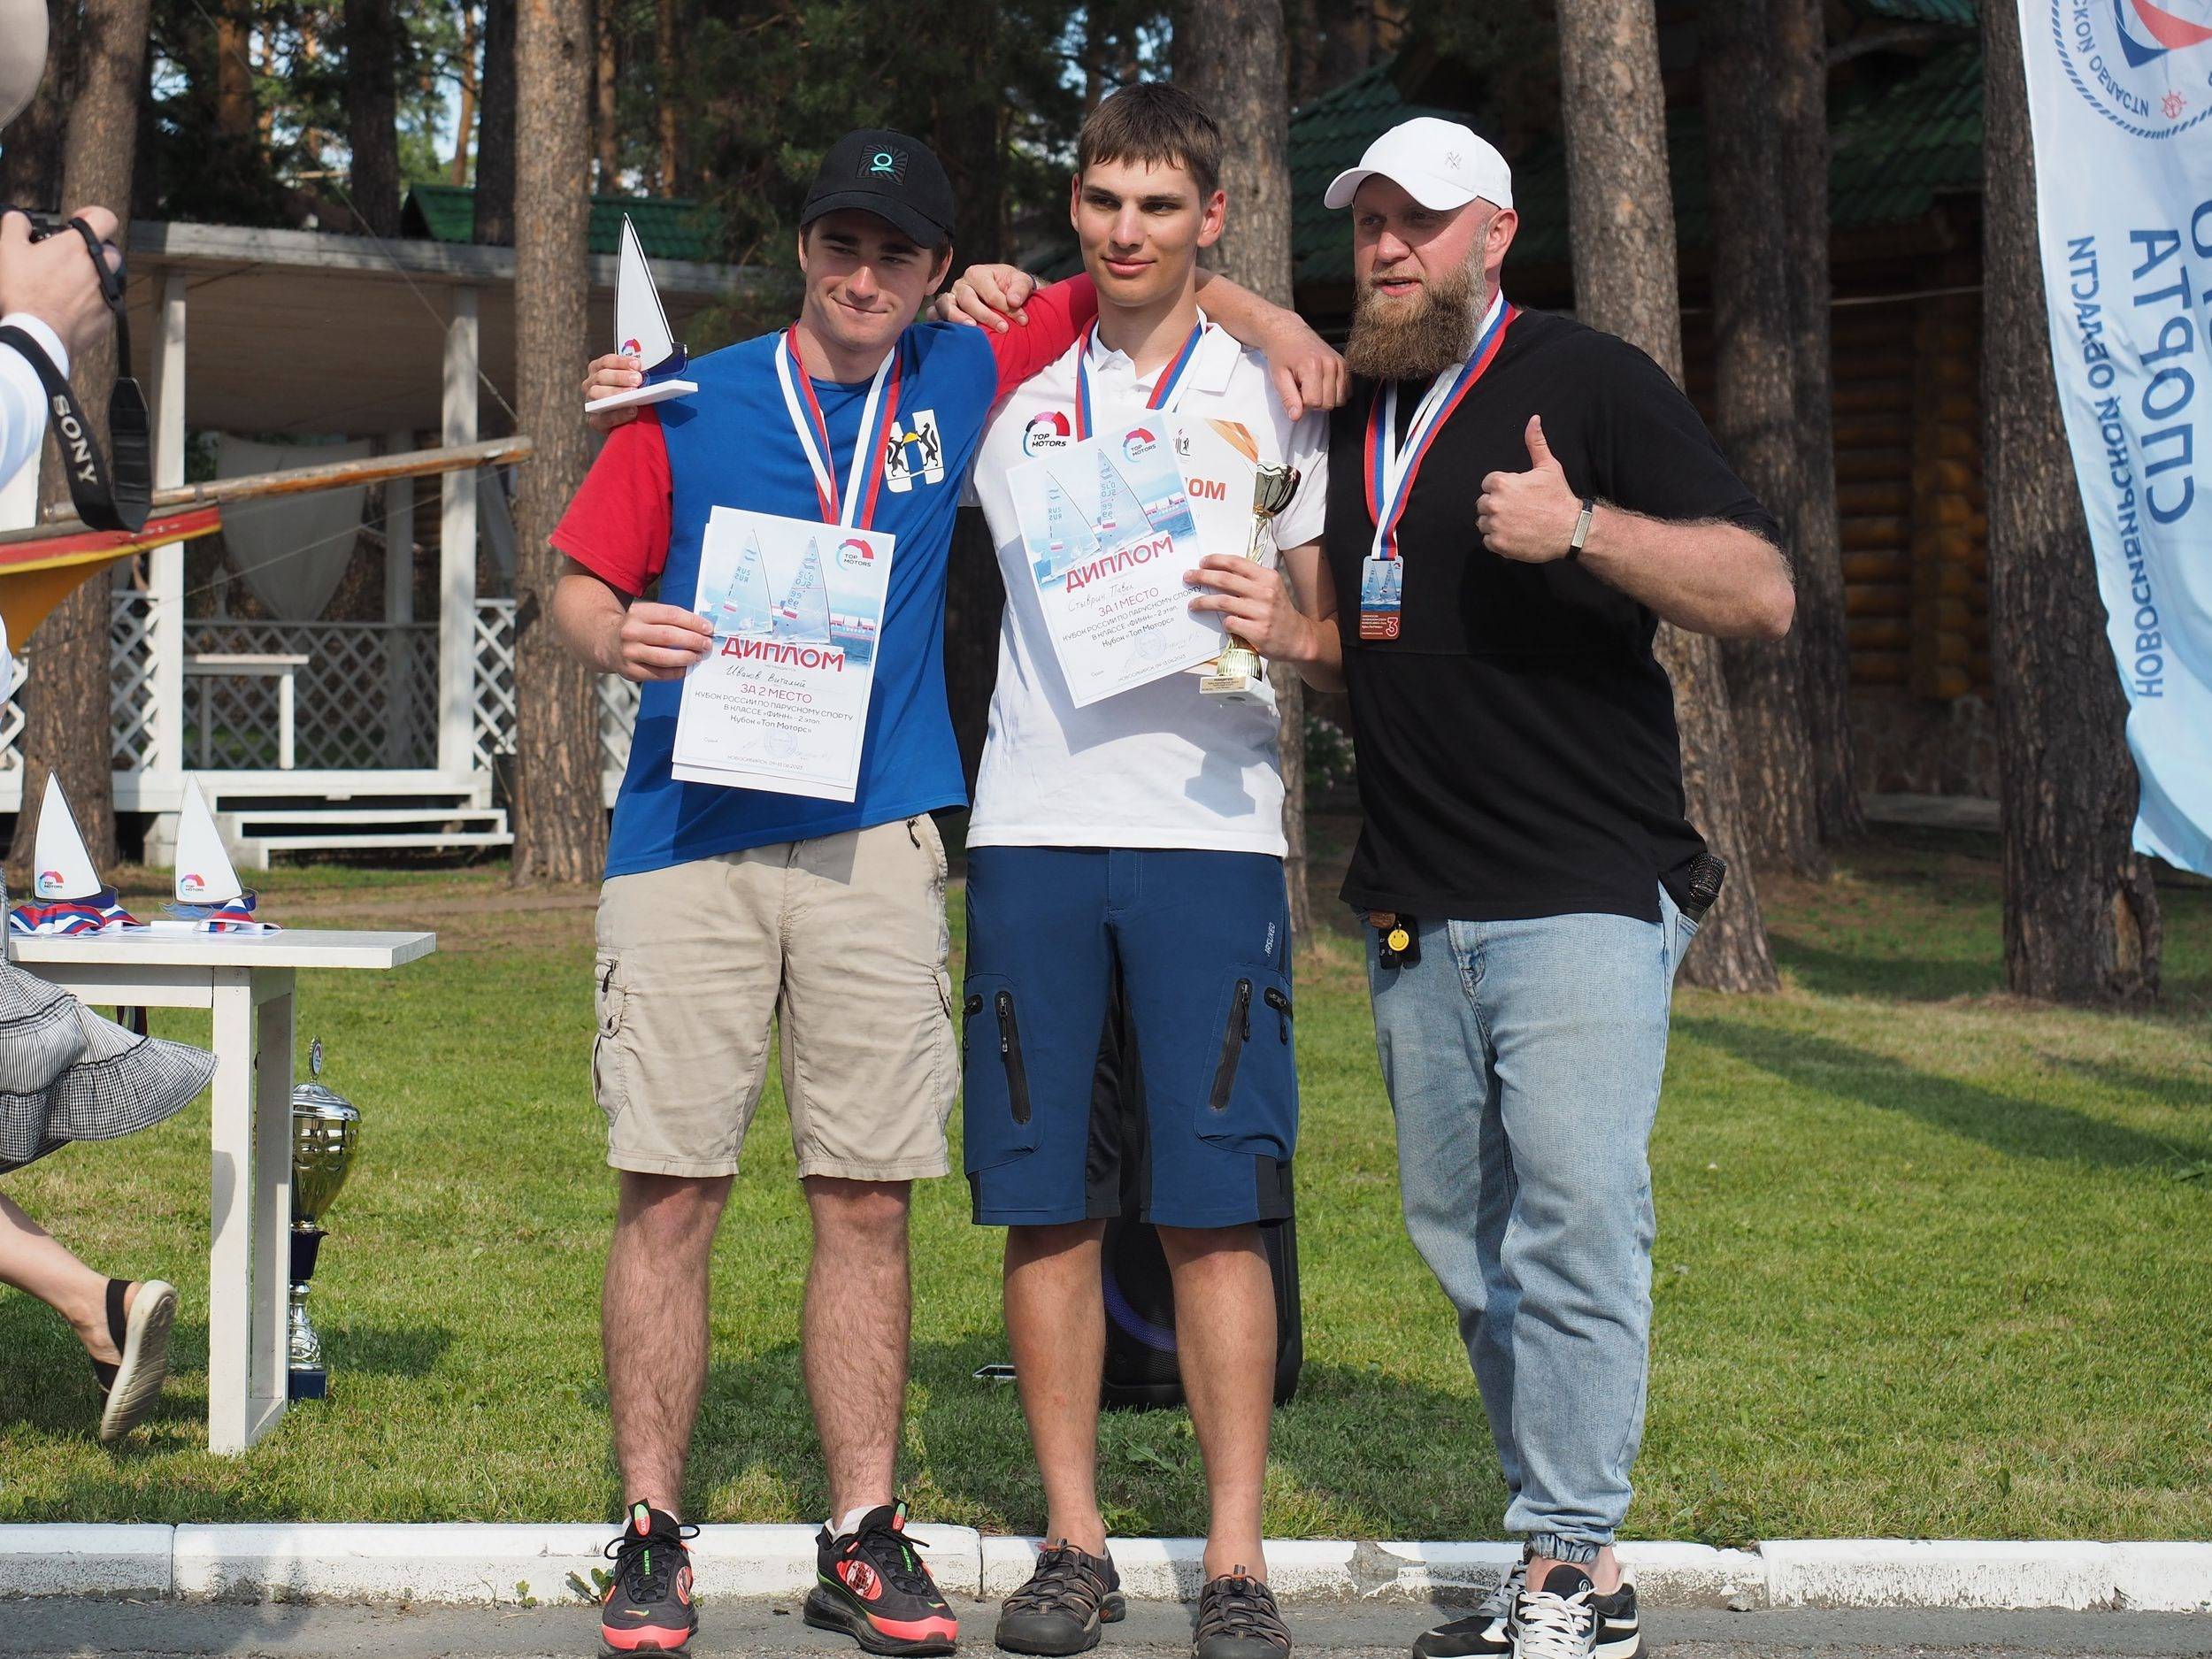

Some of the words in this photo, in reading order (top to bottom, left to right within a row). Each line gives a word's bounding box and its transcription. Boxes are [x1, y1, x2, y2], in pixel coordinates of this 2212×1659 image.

[52, 395, 98, 485] SONY
[1132, 444, 1156, 457] MOTORS
[1186, 477, 1226, 501] ОМ
[736, 566, 751, 576] RUS
[843, 558, 872, 567] MOTORS
[1066, 536, 1174, 593] ДИПЛОМ
[1098, 603, 1113, 617] ЗА
[1119, 588, 1159, 609] МЕСТО
[1062, 628, 1087, 641] КУБОК
[1087, 618, 1118, 633] РОССИИ
[1128, 596, 1173, 617] ПАРУСНОМУ
[1173, 585, 1202, 601] СПОРТУ
[1097, 624, 1125, 639] КЛАССЕ
[1386, 617, 1398, 637] 3
[1102, 634, 1125, 648] Кубок
[721, 636, 845, 672] ДИПЛОМ
[726, 664, 762, 680] Иванов
[767, 673, 807, 688] Виталий
[740, 683, 757, 695] ЗА
[758, 687, 766, 696] 2
[768, 687, 812, 703] МЕСТО
[695, 690, 722, 700] КУБОК
[723, 694, 757, 705] РОССИИ
[758, 699, 770, 708] ПО
[771, 703, 819, 716] ПАРУСНОМУ
[821, 710, 854, 721] СПОРТУ
[730, 705, 762, 716] КЛАССЕ
[730, 715, 756, 726] Кубок
